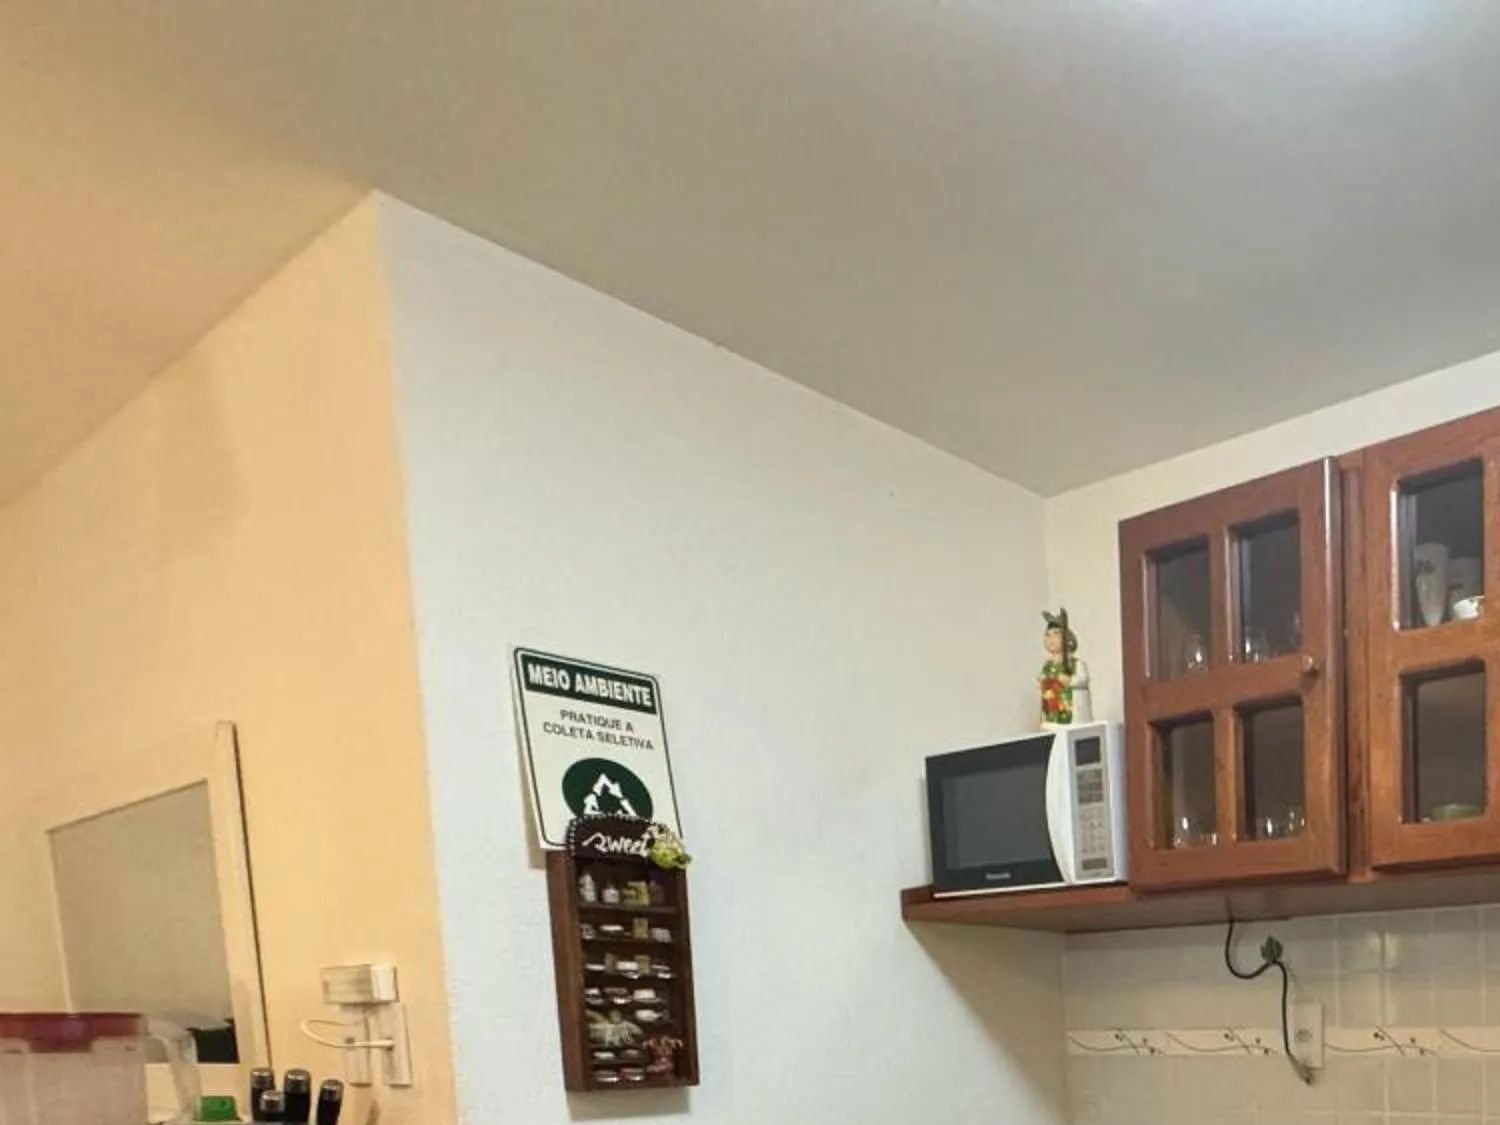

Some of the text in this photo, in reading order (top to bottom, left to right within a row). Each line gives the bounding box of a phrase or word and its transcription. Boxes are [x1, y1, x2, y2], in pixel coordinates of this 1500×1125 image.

[527, 663, 653, 706] MEIO AMBIENTE
[543, 721, 656, 750] COLETA SELETIVA
[560, 709, 635, 733] PRATIQUE A
